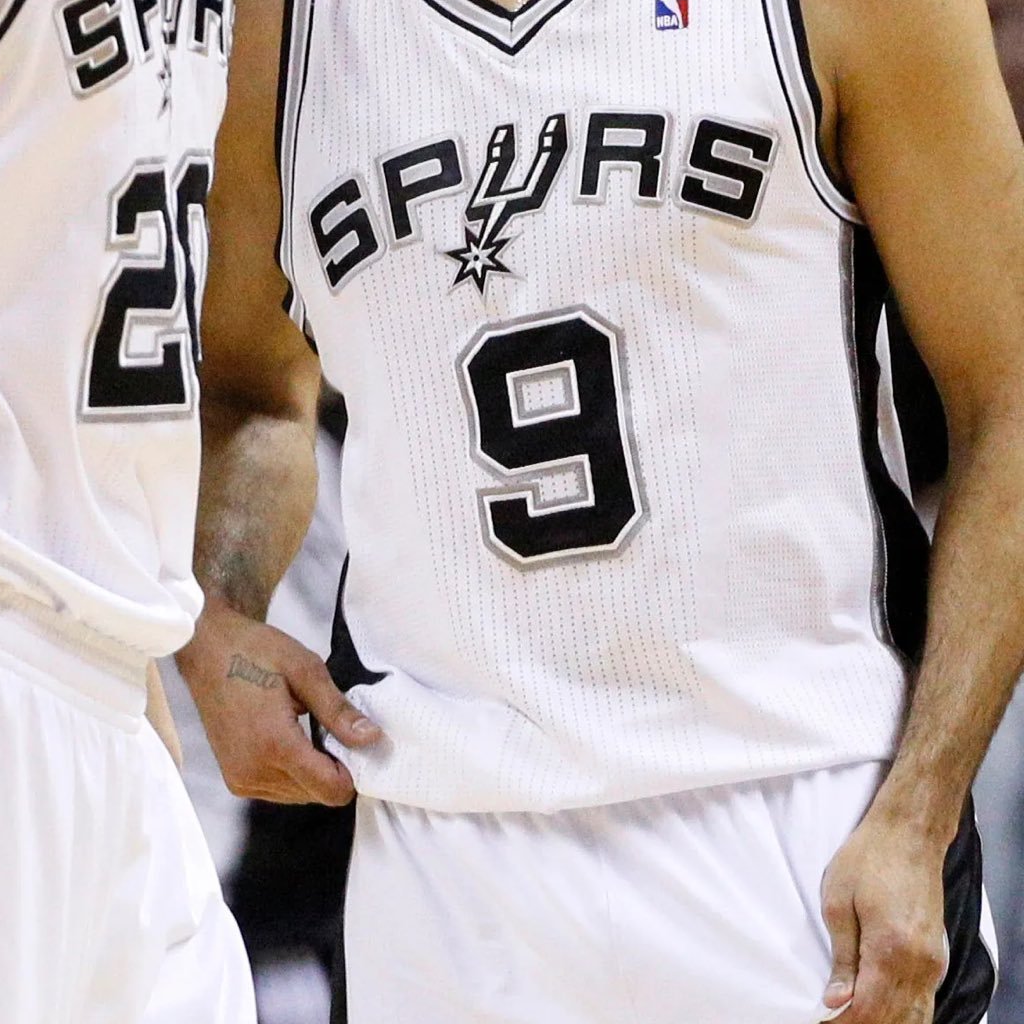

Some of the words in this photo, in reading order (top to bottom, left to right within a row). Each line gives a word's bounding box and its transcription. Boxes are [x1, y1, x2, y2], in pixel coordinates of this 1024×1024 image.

[656, 14, 678, 28] NBA
[307, 106, 779, 297] SPURS
[455, 302, 650, 572] 9
